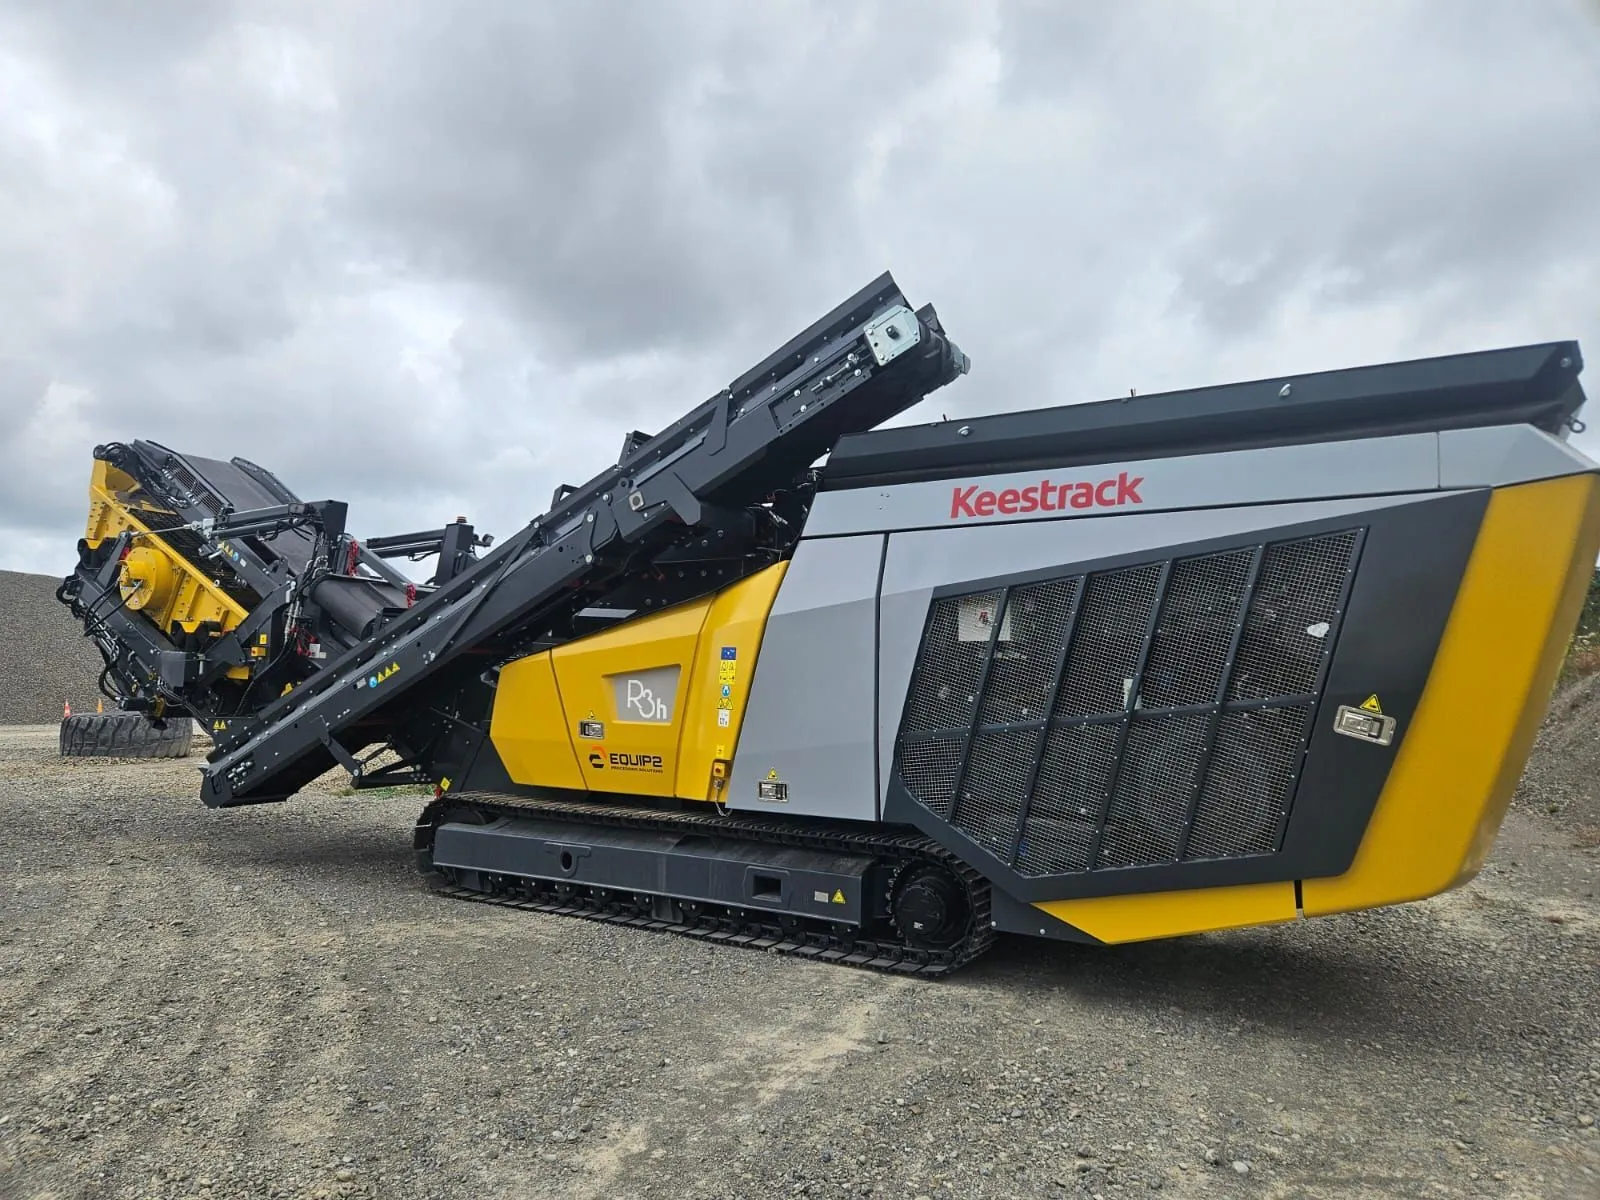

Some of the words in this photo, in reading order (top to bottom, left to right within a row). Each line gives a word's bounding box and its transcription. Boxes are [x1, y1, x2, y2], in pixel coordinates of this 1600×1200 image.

[950, 472, 1144, 519] Keestrack
[628, 680, 667, 719] R3h
[609, 753, 663, 767] EQUIP2
